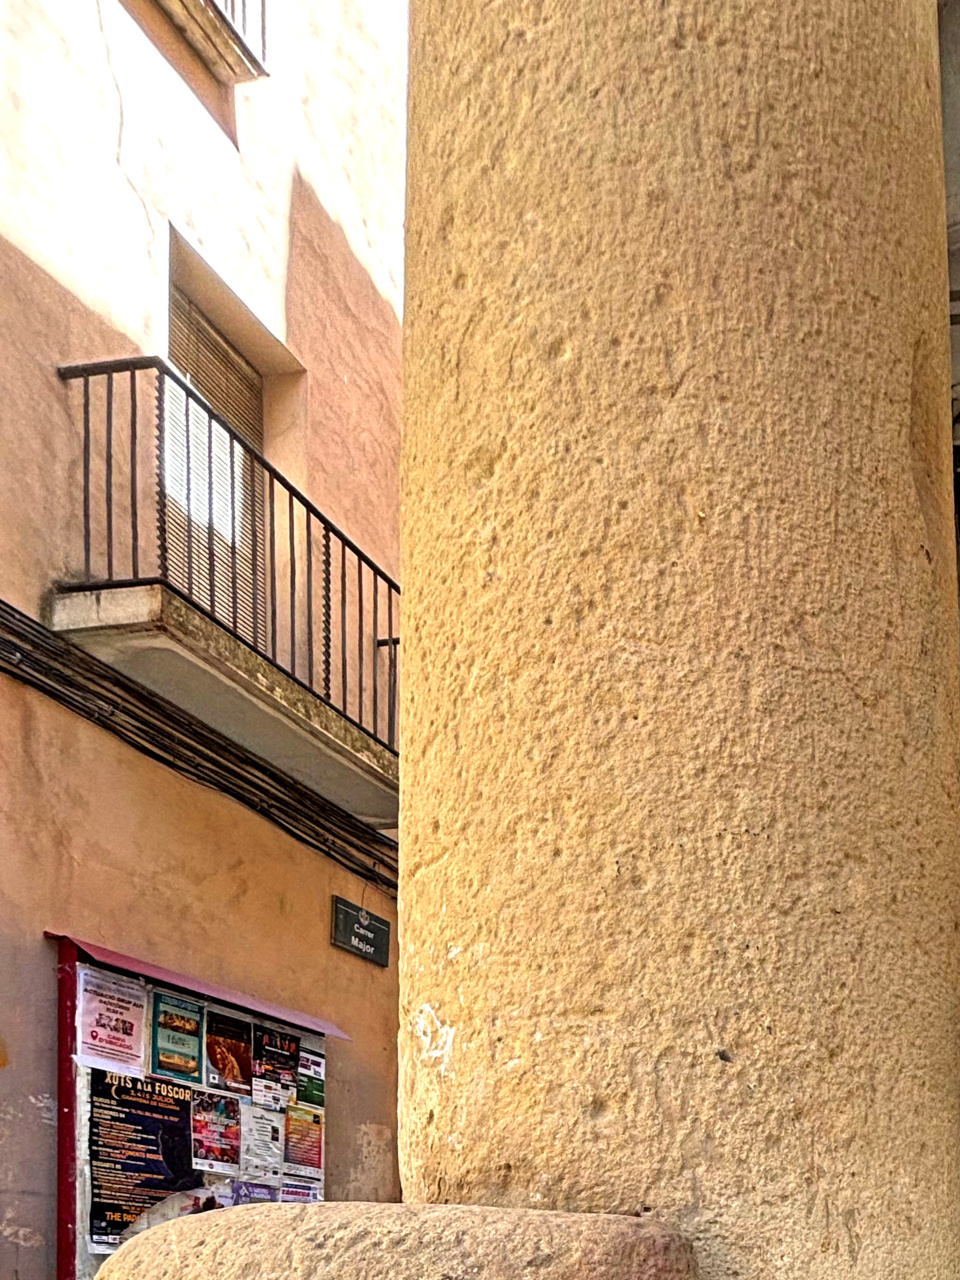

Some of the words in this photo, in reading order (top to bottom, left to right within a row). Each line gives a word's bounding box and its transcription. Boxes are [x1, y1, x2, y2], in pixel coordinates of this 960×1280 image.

[354, 924, 374, 939] Carrer
[351, 936, 375, 954] Major
[105, 1071, 133, 1088] XUTS
[155, 1082, 191, 1101] FOSCOR
[105, 1211, 122, 1221] THE
